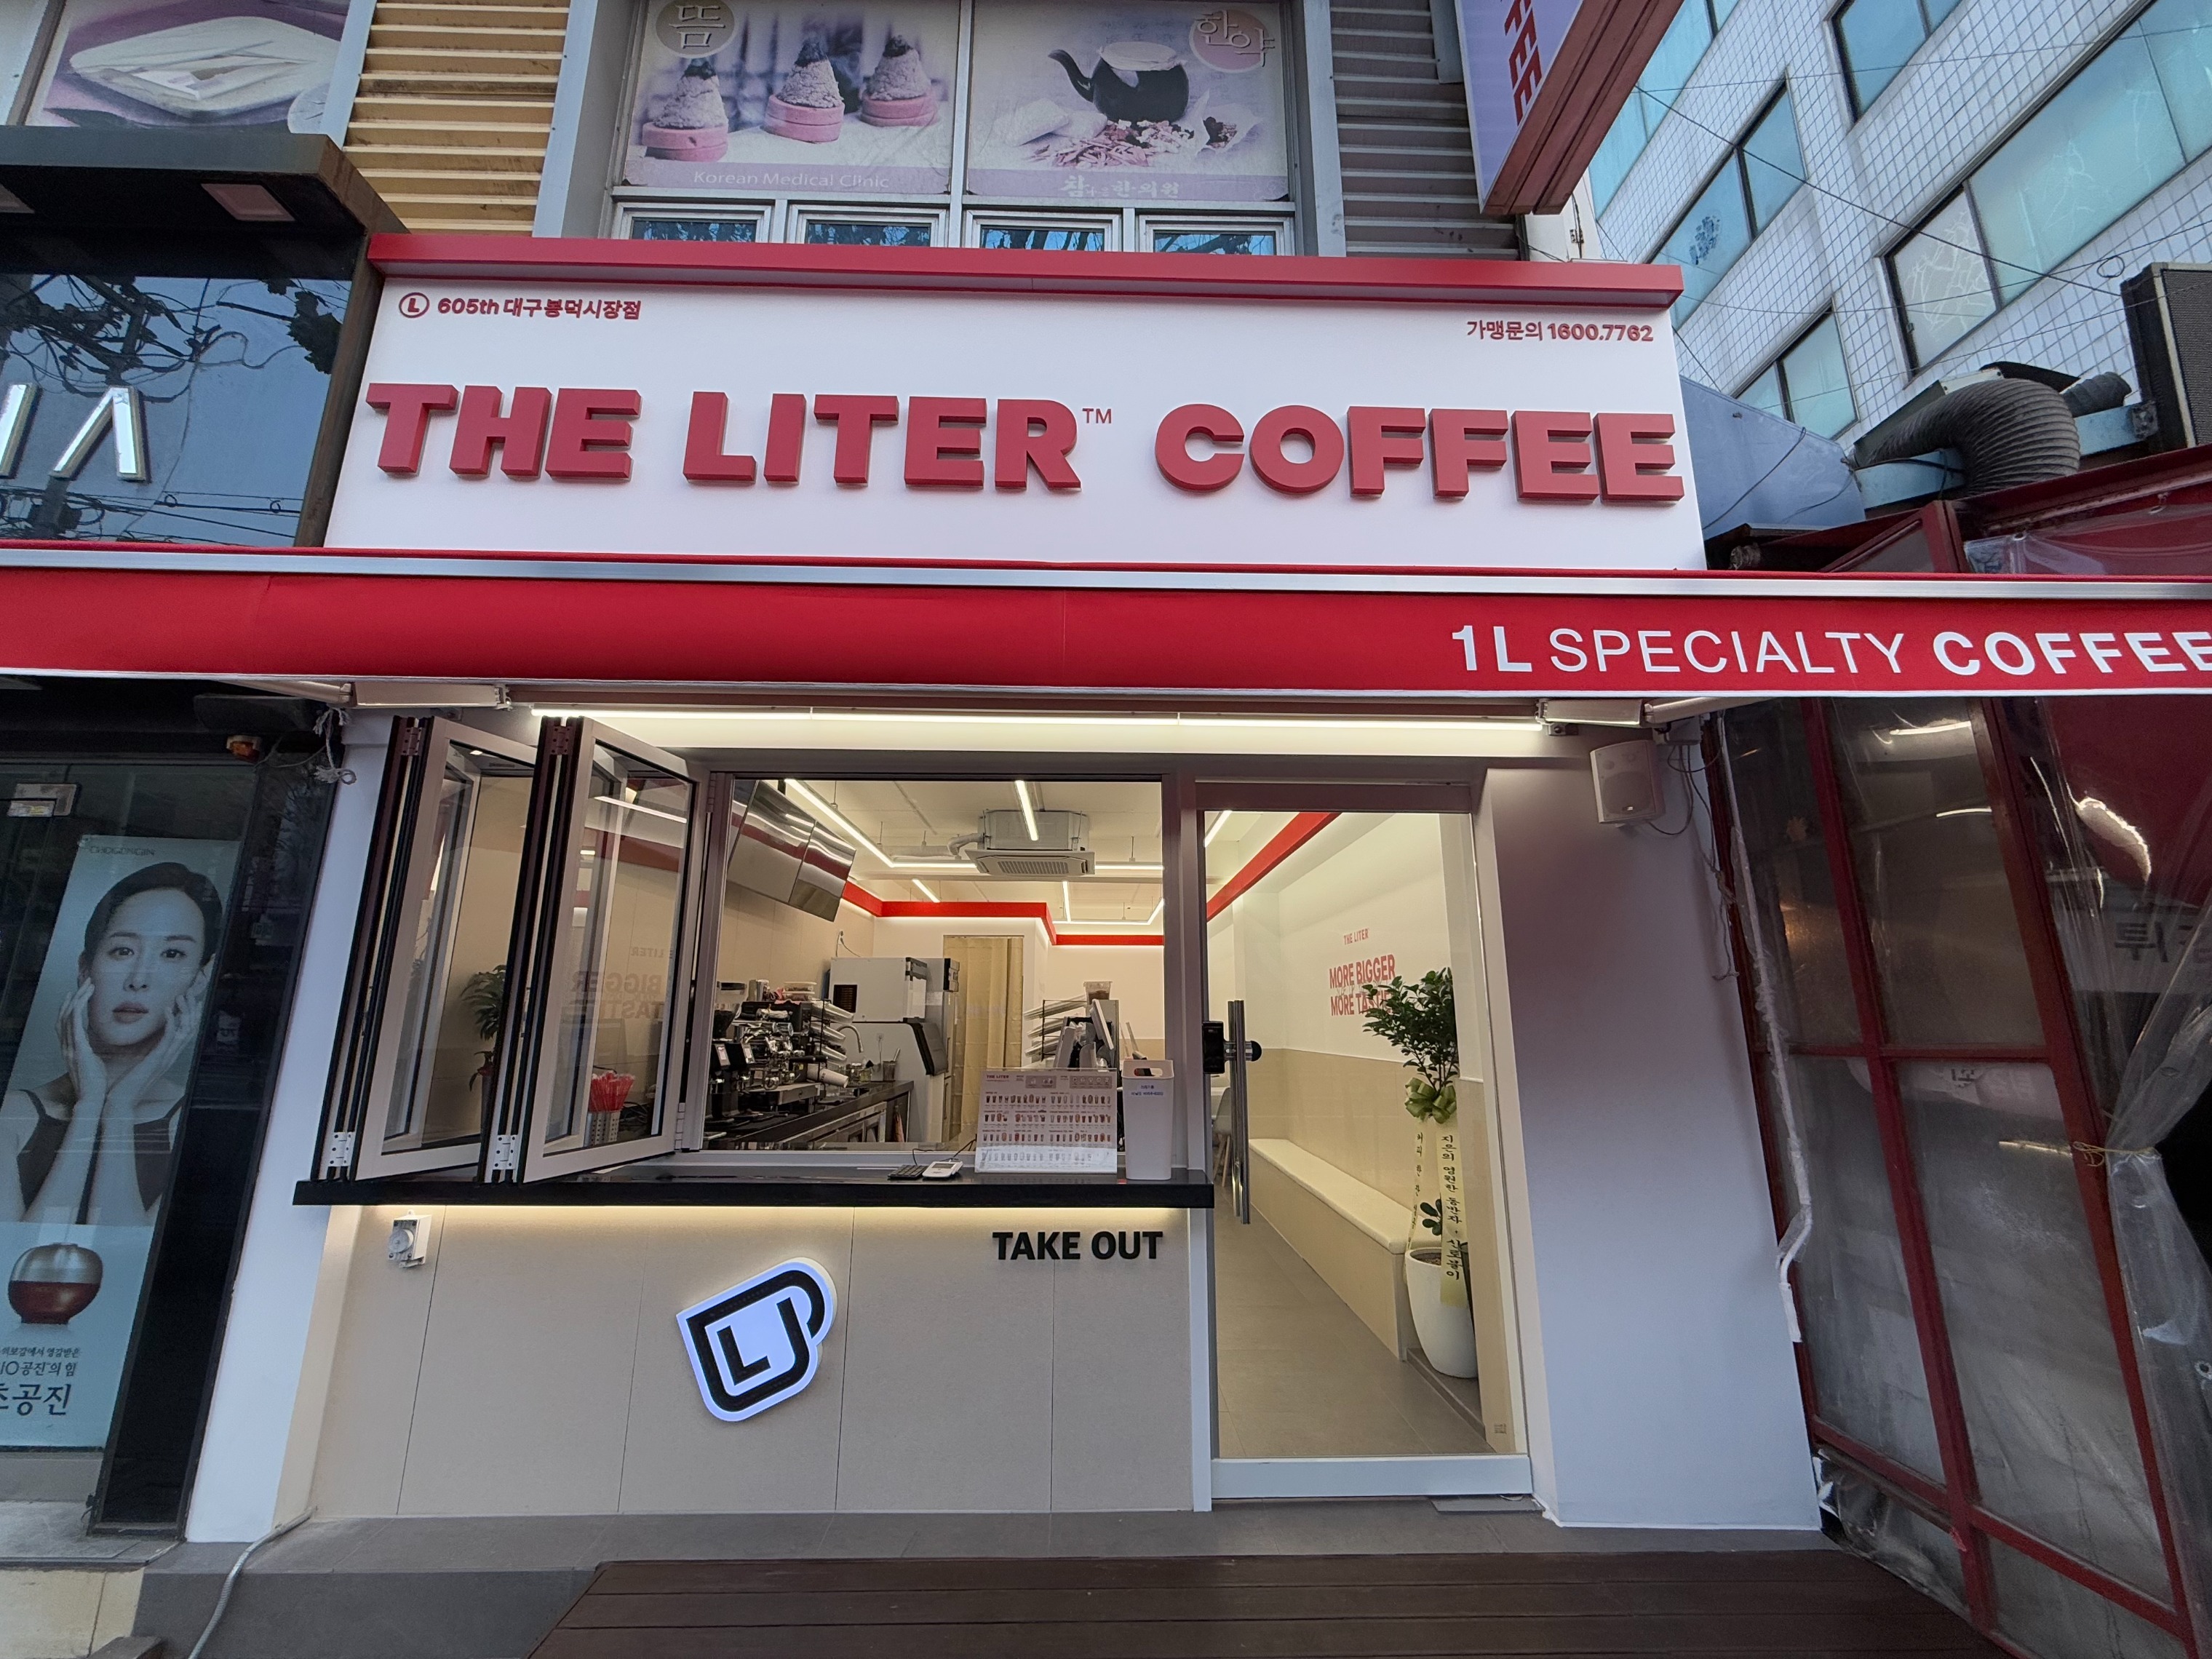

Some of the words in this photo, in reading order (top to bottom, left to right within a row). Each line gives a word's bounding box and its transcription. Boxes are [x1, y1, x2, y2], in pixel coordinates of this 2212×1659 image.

[669, 4, 725, 49] 뜸
[1194, 9, 1276, 68] 한약
[694, 171, 758, 185] Korean
[764, 172, 834, 187] Medical
[839, 175, 889, 188] Clinic
[437, 298, 500, 315] 605th
[503, 298, 642, 319] 대구봉덕시장점
[1467, 320, 1543, 341] 가맹문의
[1547, 323, 1654, 342] 1600.7762
[366, 383, 642, 481] THE
[683, 391, 1082, 490] LITER
[1155, 403, 1685, 502] COFFEE
[1452, 625, 1532, 672] 1L
[1548, 628, 1905, 674] SPECIALTY
[1933, 631, 2212, 675] COFFEE
[1344, 934, 1353, 945] THE
[1354, 928, 1369, 942] LITER
[1329, 963, 1354, 989] MORE
[1356, 954, 1396, 984] BIGGER
[1331, 994, 1355, 1017] MORE
[992, 1231, 1081, 1260] TAKE
[1091, 1230, 1163, 1260] OUT
[65, 1361, 78, 1377] 힘
